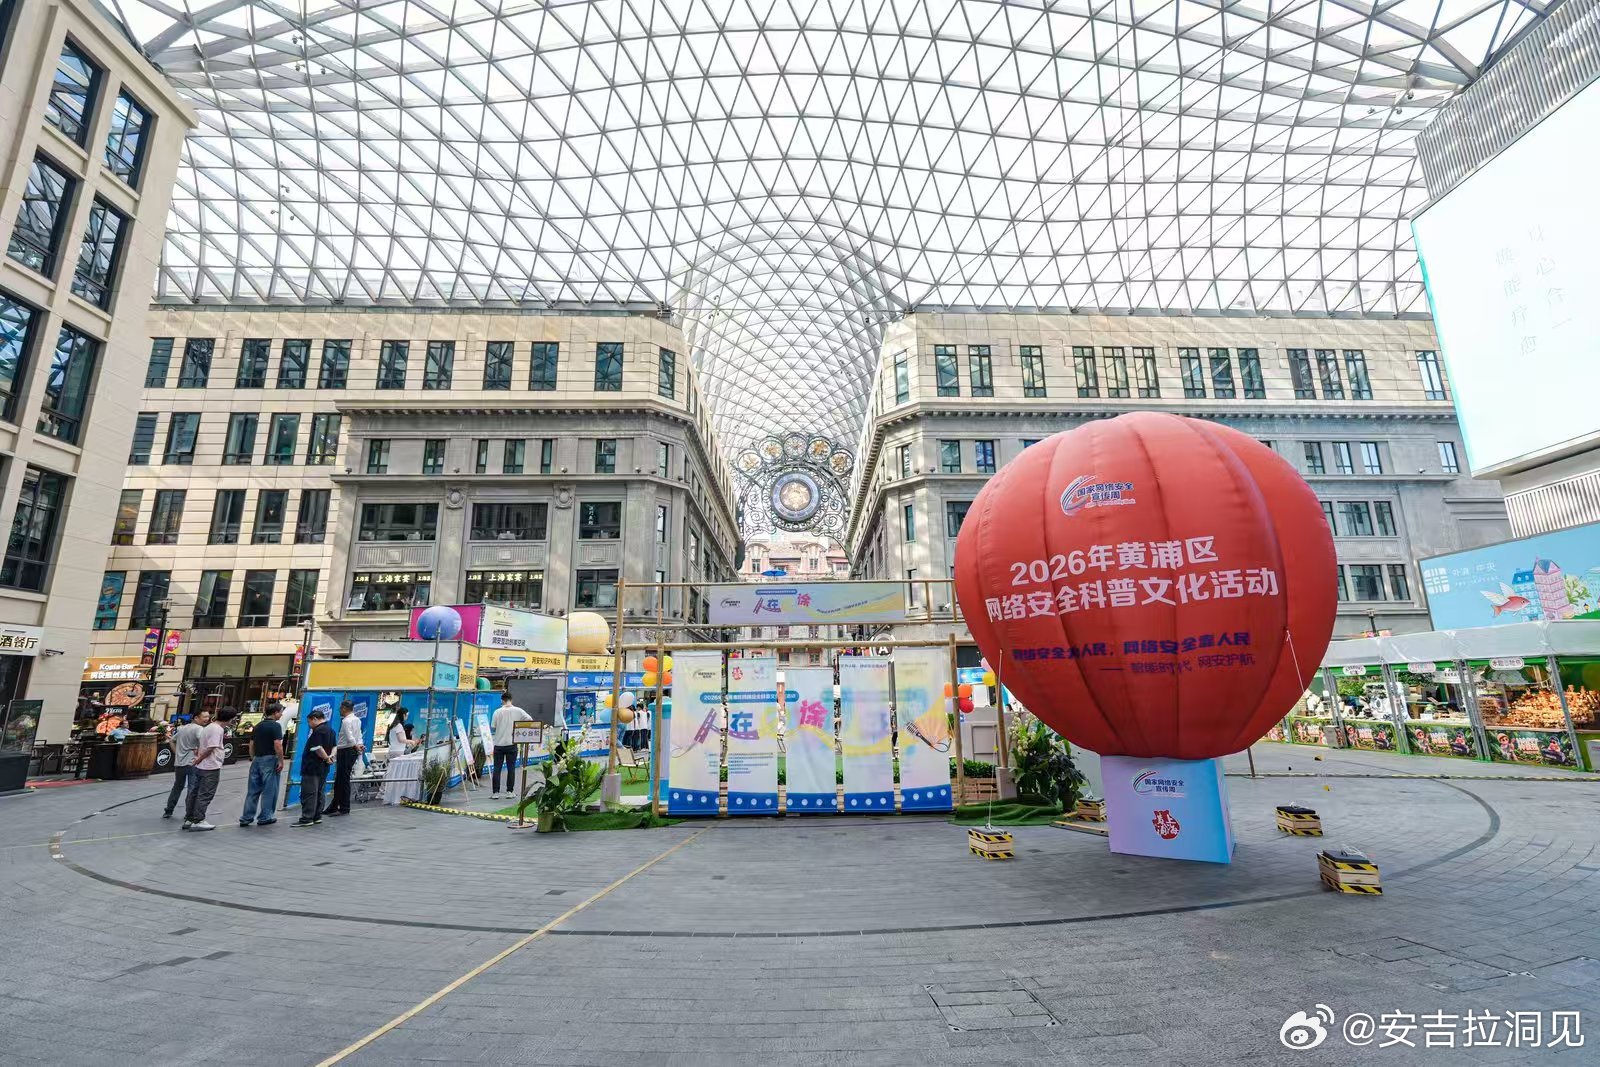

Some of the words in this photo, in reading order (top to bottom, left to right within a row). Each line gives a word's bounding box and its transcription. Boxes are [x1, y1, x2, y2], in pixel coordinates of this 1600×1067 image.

[1077, 482, 1133, 496] 国家网络安全
[1091, 491, 1121, 501] 宣传周
[1009, 535, 1219, 587] 2026年黄浦区
[985, 567, 1279, 624] 网络安全科普文化活动
